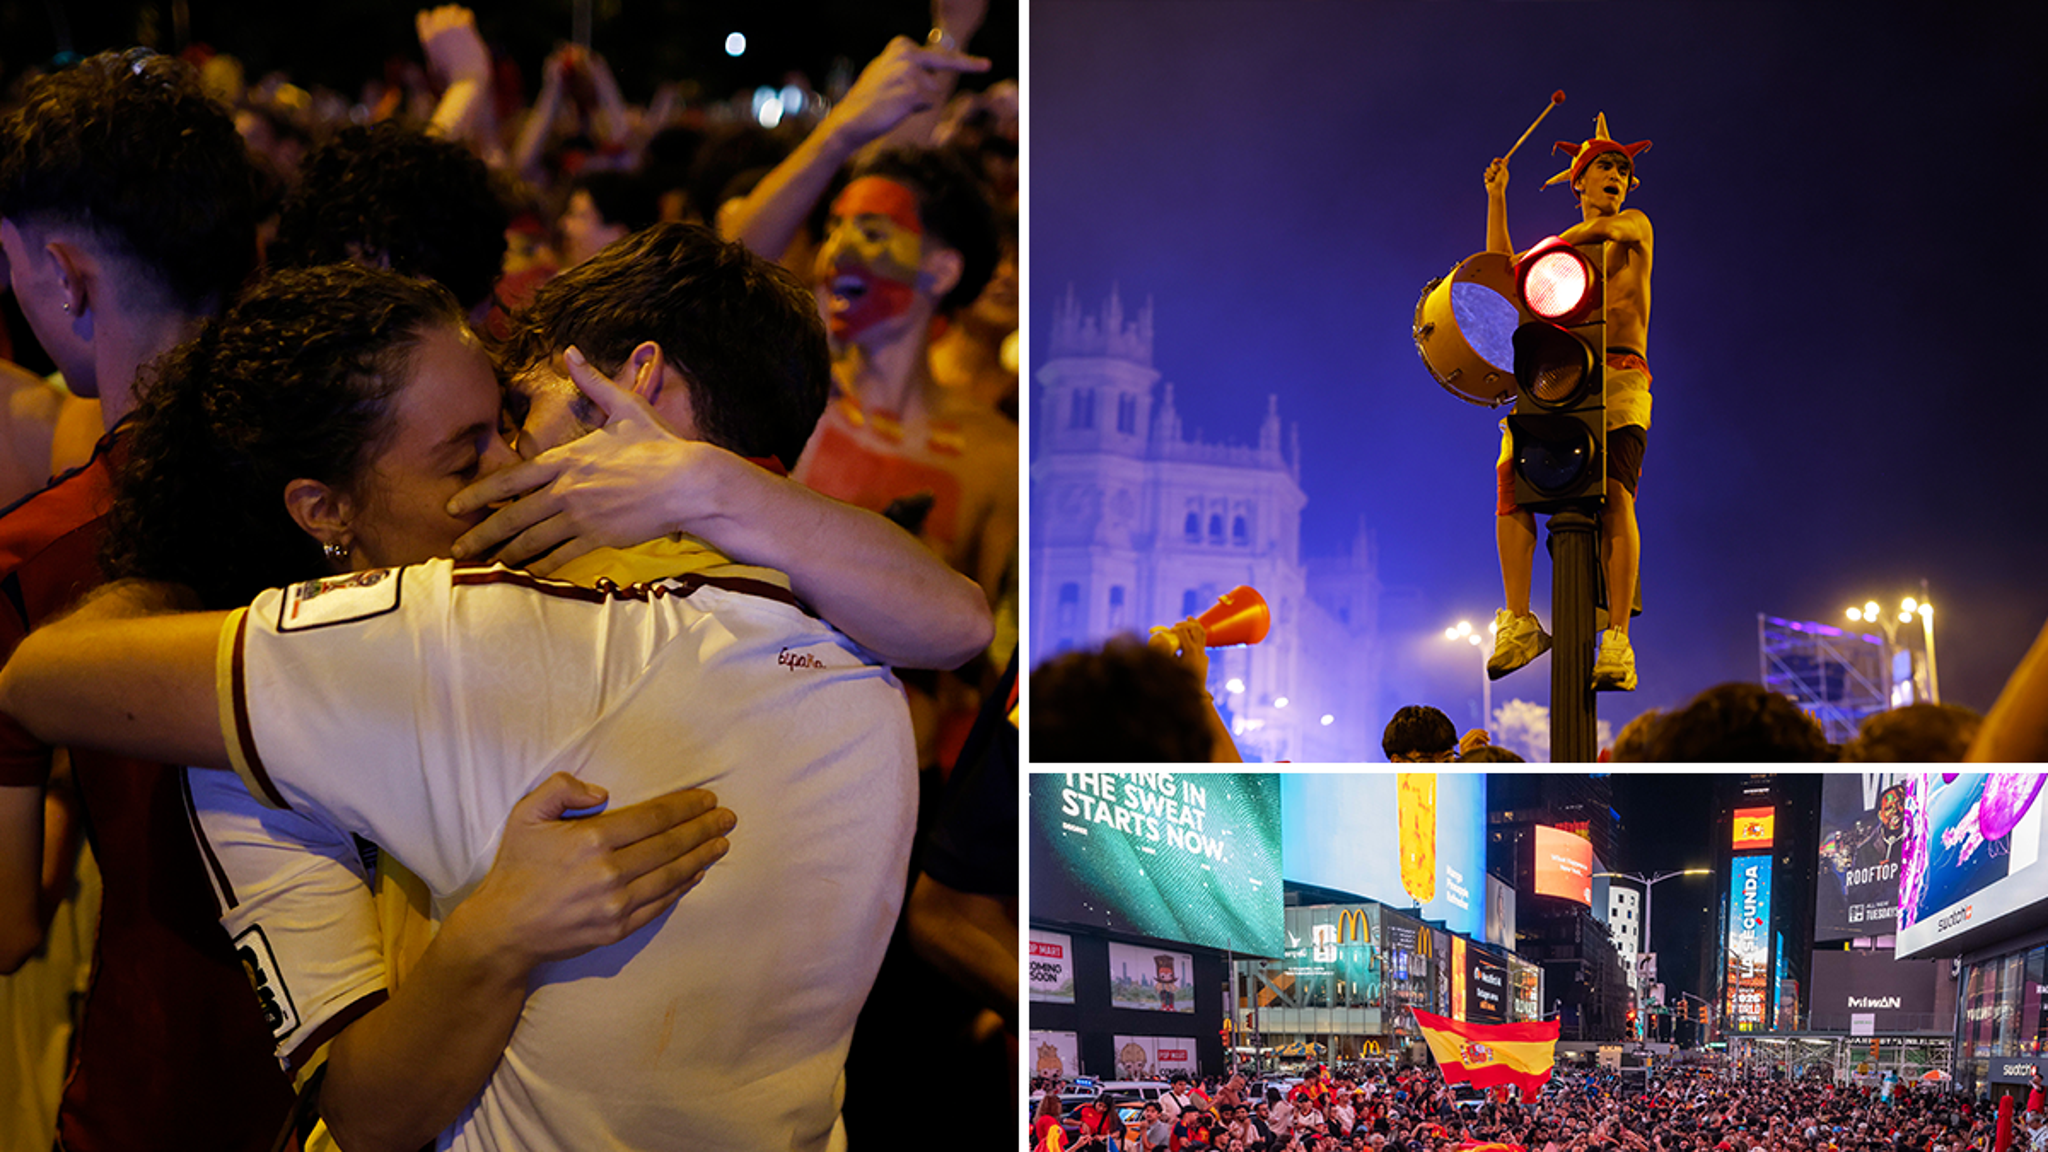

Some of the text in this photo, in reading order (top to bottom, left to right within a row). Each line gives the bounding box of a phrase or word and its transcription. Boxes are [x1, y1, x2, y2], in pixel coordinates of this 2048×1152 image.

[1123, 783, 1206, 832] SWEAT
[1182, 780, 1206, 811] IN
[1061, 788, 1229, 864] STARTS NOW.
[1845, 863, 1899, 887] ROOFTOP
[1029, 971, 1057, 983] SOON
[1741, 956, 1754, 979] LA
[2003, 1063, 2031, 1076] swatch
